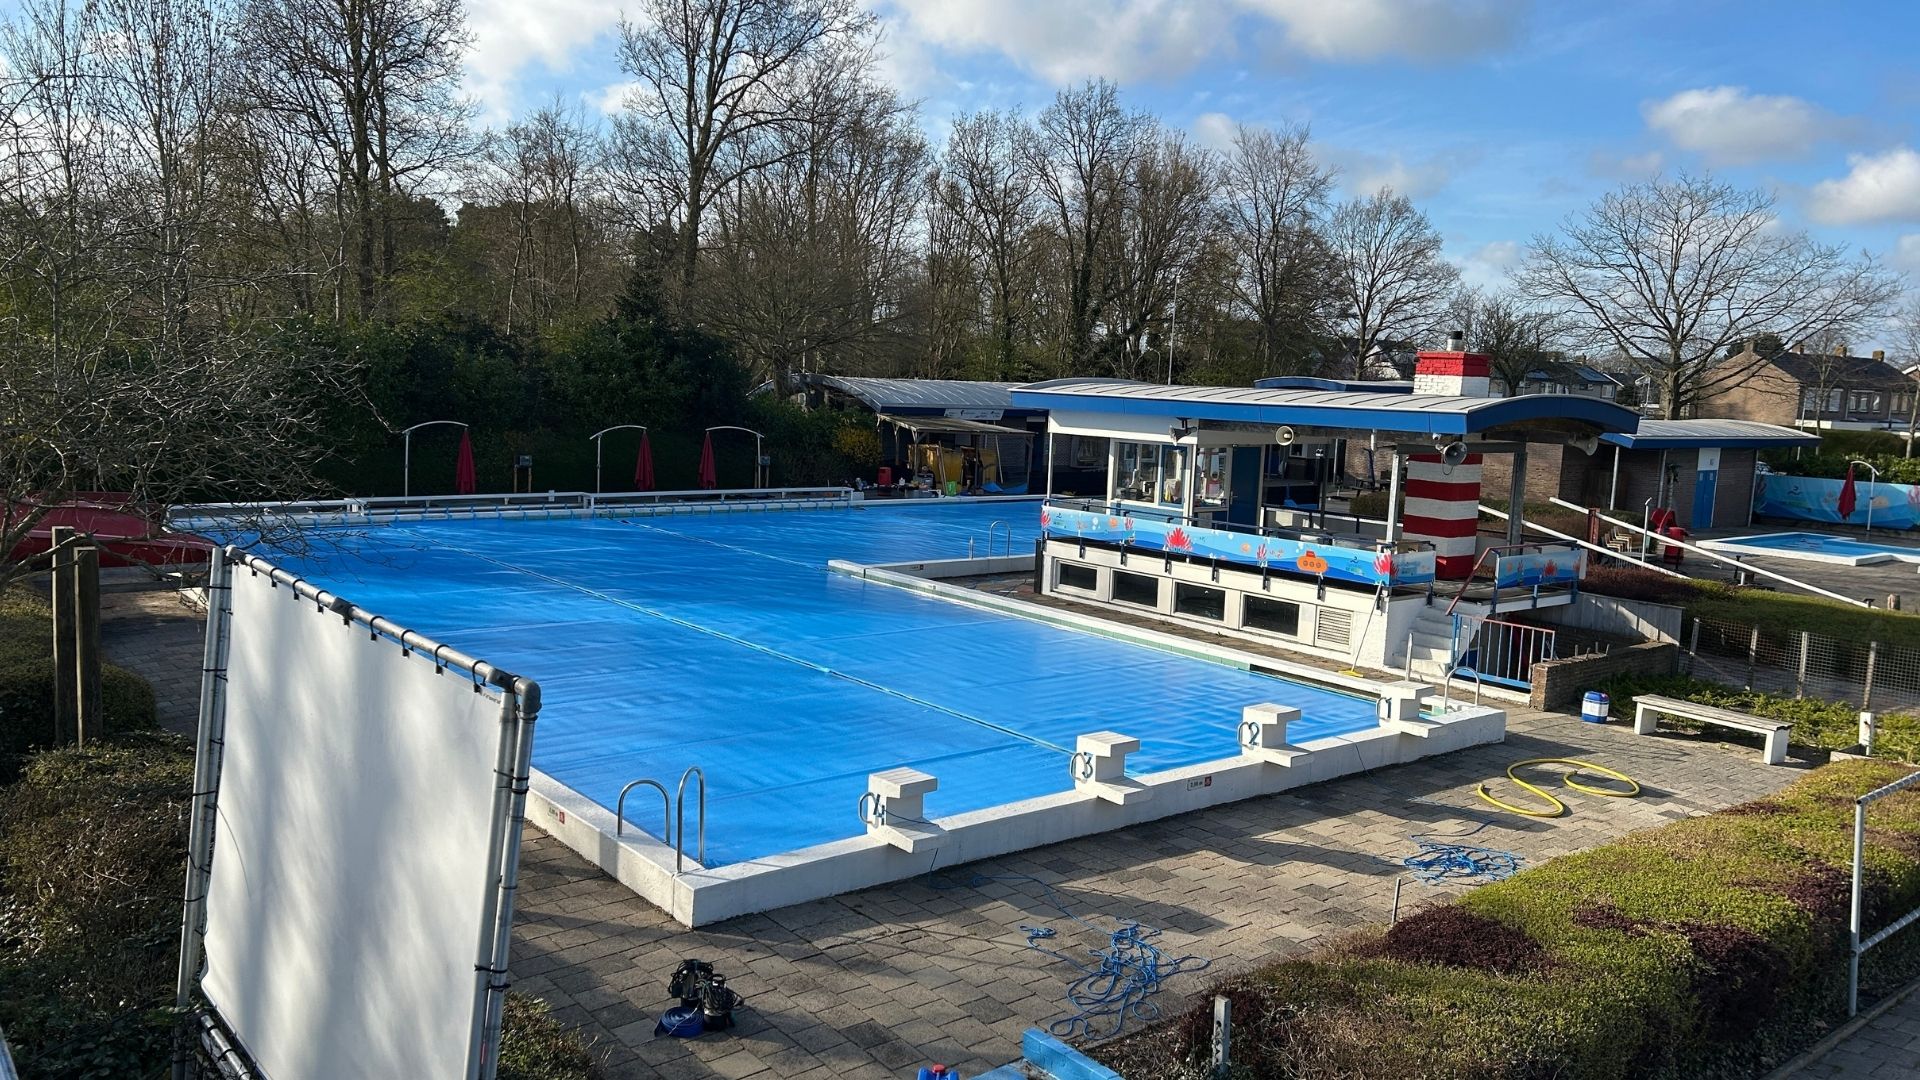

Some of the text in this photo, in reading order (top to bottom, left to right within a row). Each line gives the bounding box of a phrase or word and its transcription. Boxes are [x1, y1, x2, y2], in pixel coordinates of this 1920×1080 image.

[1385, 697, 1392, 718] 1
[1248, 721, 1259, 746] 2
[1082, 751, 1093, 779] 3
[872, 793, 885, 826] 4
